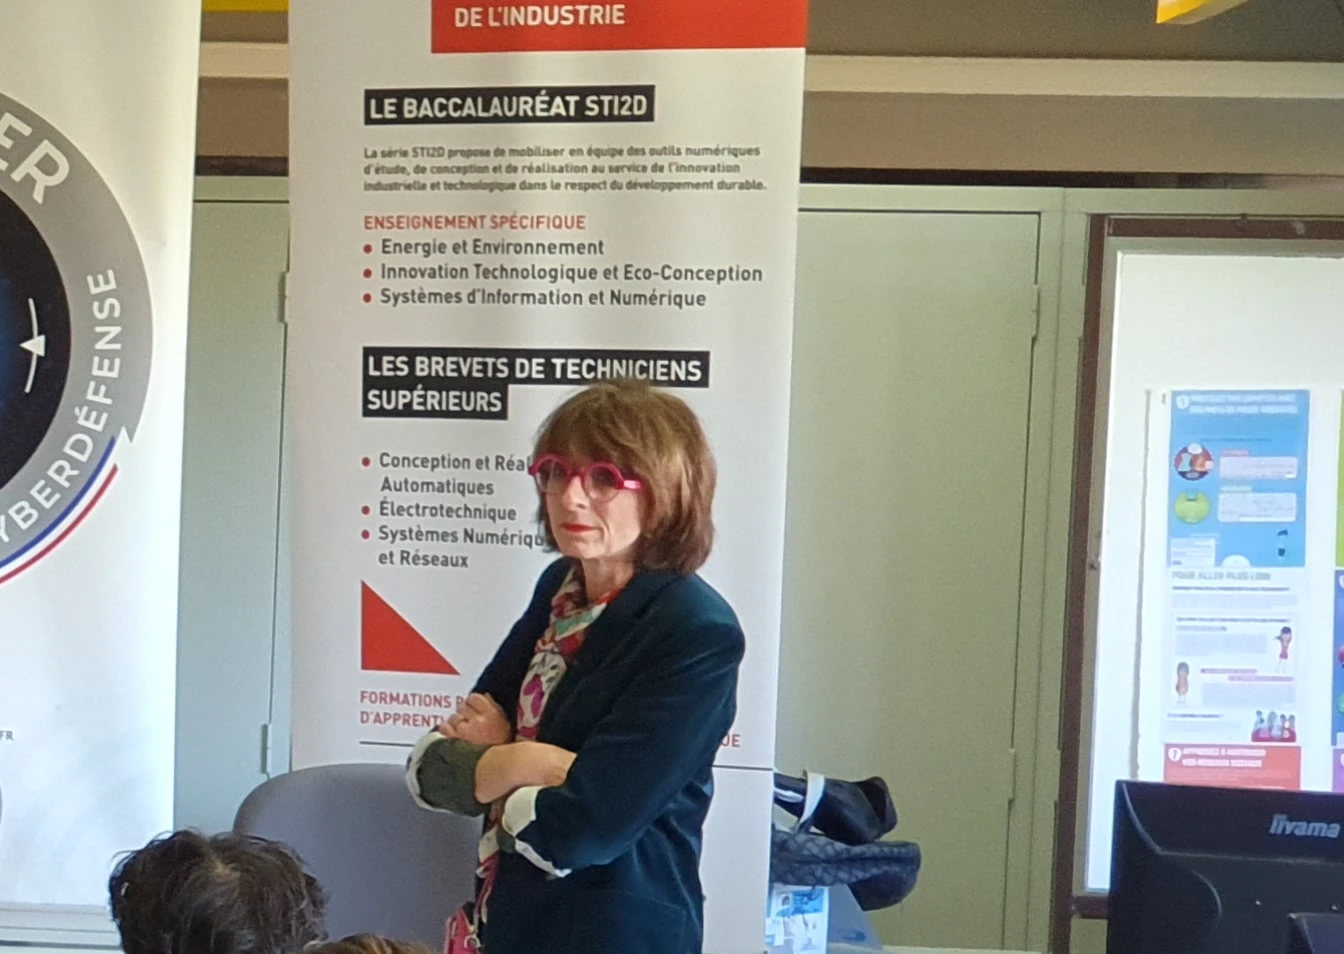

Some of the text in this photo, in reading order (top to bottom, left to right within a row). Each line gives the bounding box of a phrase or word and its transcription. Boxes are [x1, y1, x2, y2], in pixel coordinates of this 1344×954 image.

[455, 4, 625, 28] DE L'INDUSTRIE
[369, 90, 648, 119] LE BACCALAURÉAT STI2D
[364, 144, 761, 160] La série STI2D propose de mobiliser en équipe des outils numériques
[363, 161, 740, 176] d'étude, de conception et de réalisation au service de l'innovation
[364, 179, 768, 193] industrielle et technologique dans le respect du développement durable.
[363, 210, 587, 230] ENSEIGNEMENT SPÉCIFIQUE
[381, 237, 604, 258] Energie et Environnement
[380, 262, 764, 286] Innovation Technologique et Eco-Conception
[379, 286, 707, 310] Systèmes d'Information et Numérique
[368, 355, 703, 382] LES BREVETS DE TECHNICIENS
[367, 383, 503, 412] SUPÉRIEURS
[379, 452, 471, 473] Conception
[475, 454, 491, 471] et
[380, 476, 495, 497] Automatiques
[379, 495, 518, 524] Électrotechnique
[378, 524, 459, 545] Systèmes
[378, 548, 469, 568] et Réseaux
[360, 690, 452, 709] FORMATIONS
